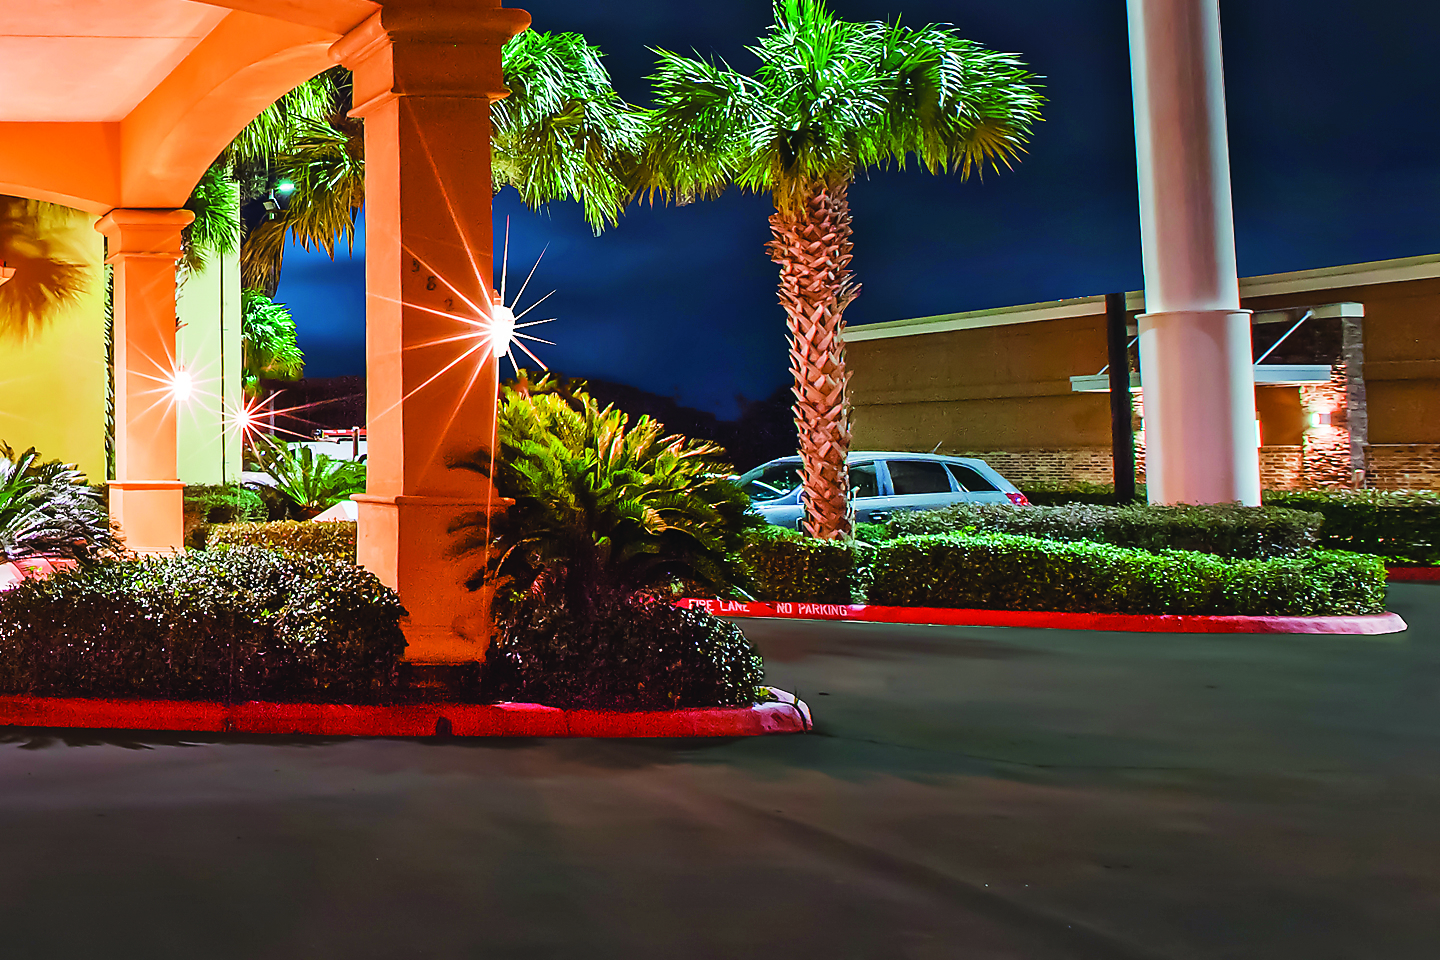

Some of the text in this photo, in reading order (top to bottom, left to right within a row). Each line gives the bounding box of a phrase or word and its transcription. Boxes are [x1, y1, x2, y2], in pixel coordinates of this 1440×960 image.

[719, 600, 750, 612] LANE
[776, 602, 792, 614] NO
[798, 603, 848, 616] PARKING
